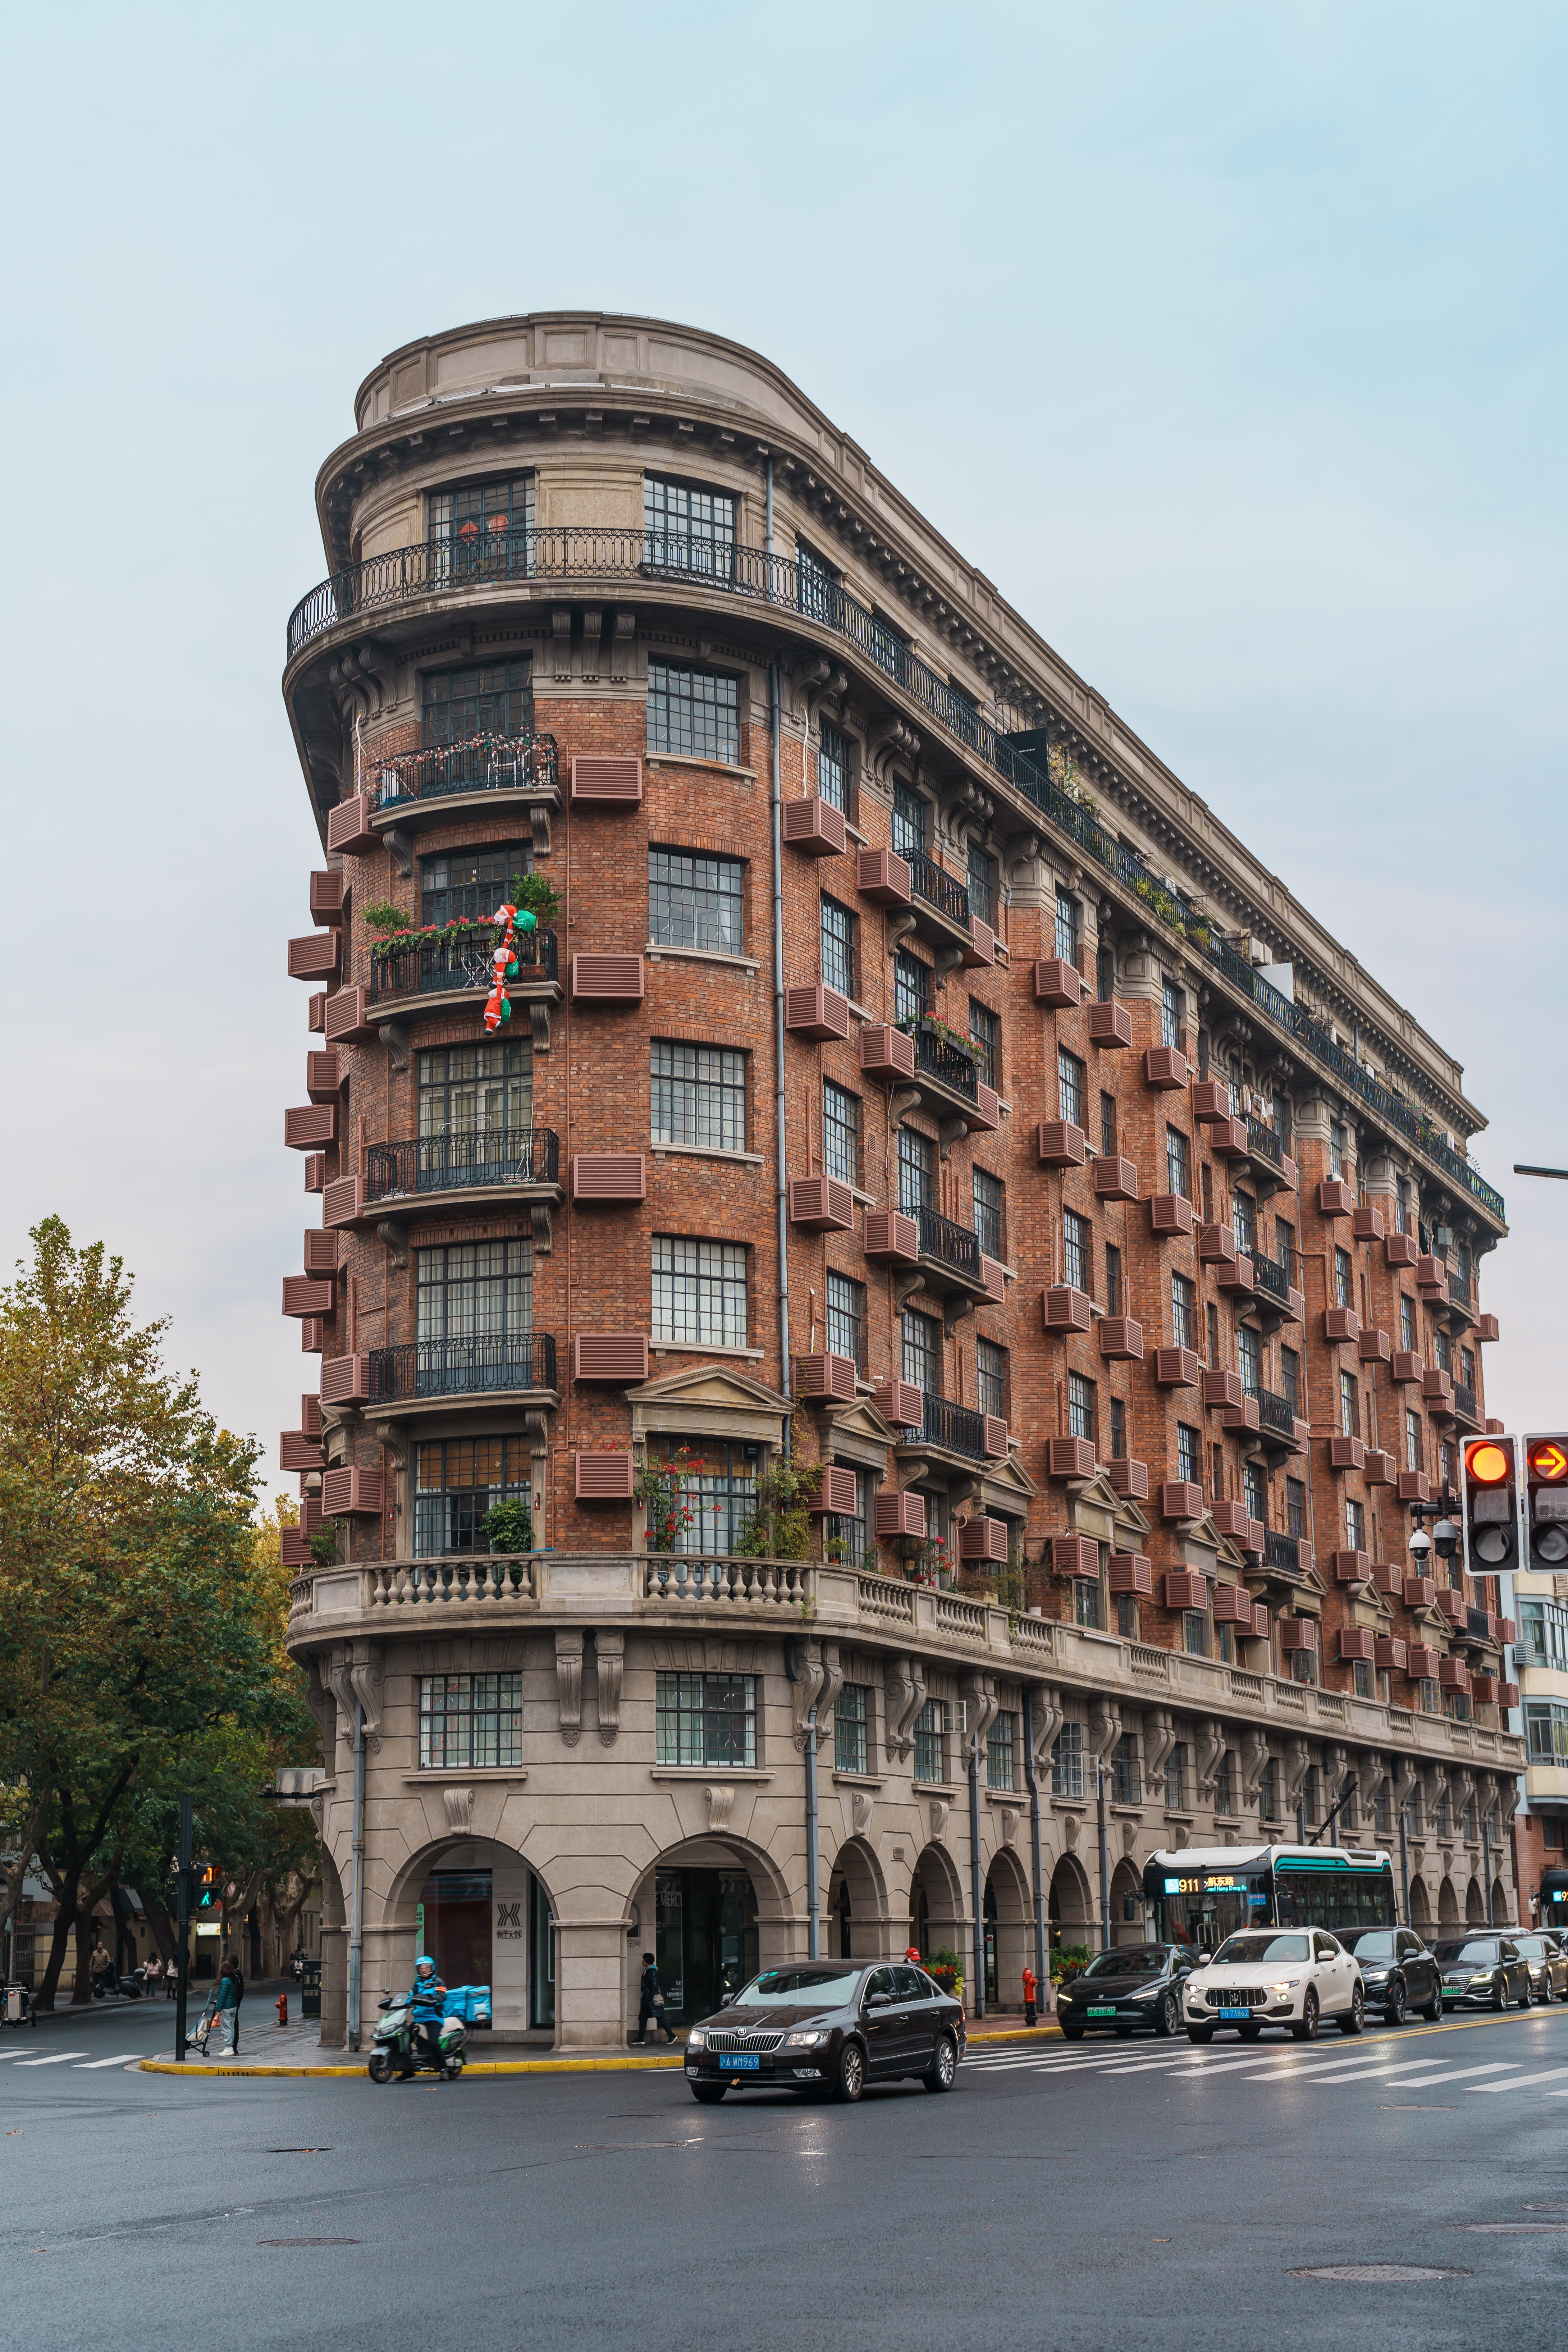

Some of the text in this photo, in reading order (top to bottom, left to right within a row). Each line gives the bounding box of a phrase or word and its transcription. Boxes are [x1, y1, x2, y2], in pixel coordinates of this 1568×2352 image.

[1179, 1876, 1234, 1892] 911 航东路
[497, 1930, 522, 1939] 新华文创
[627, 1938, 641, 1947] 空间
